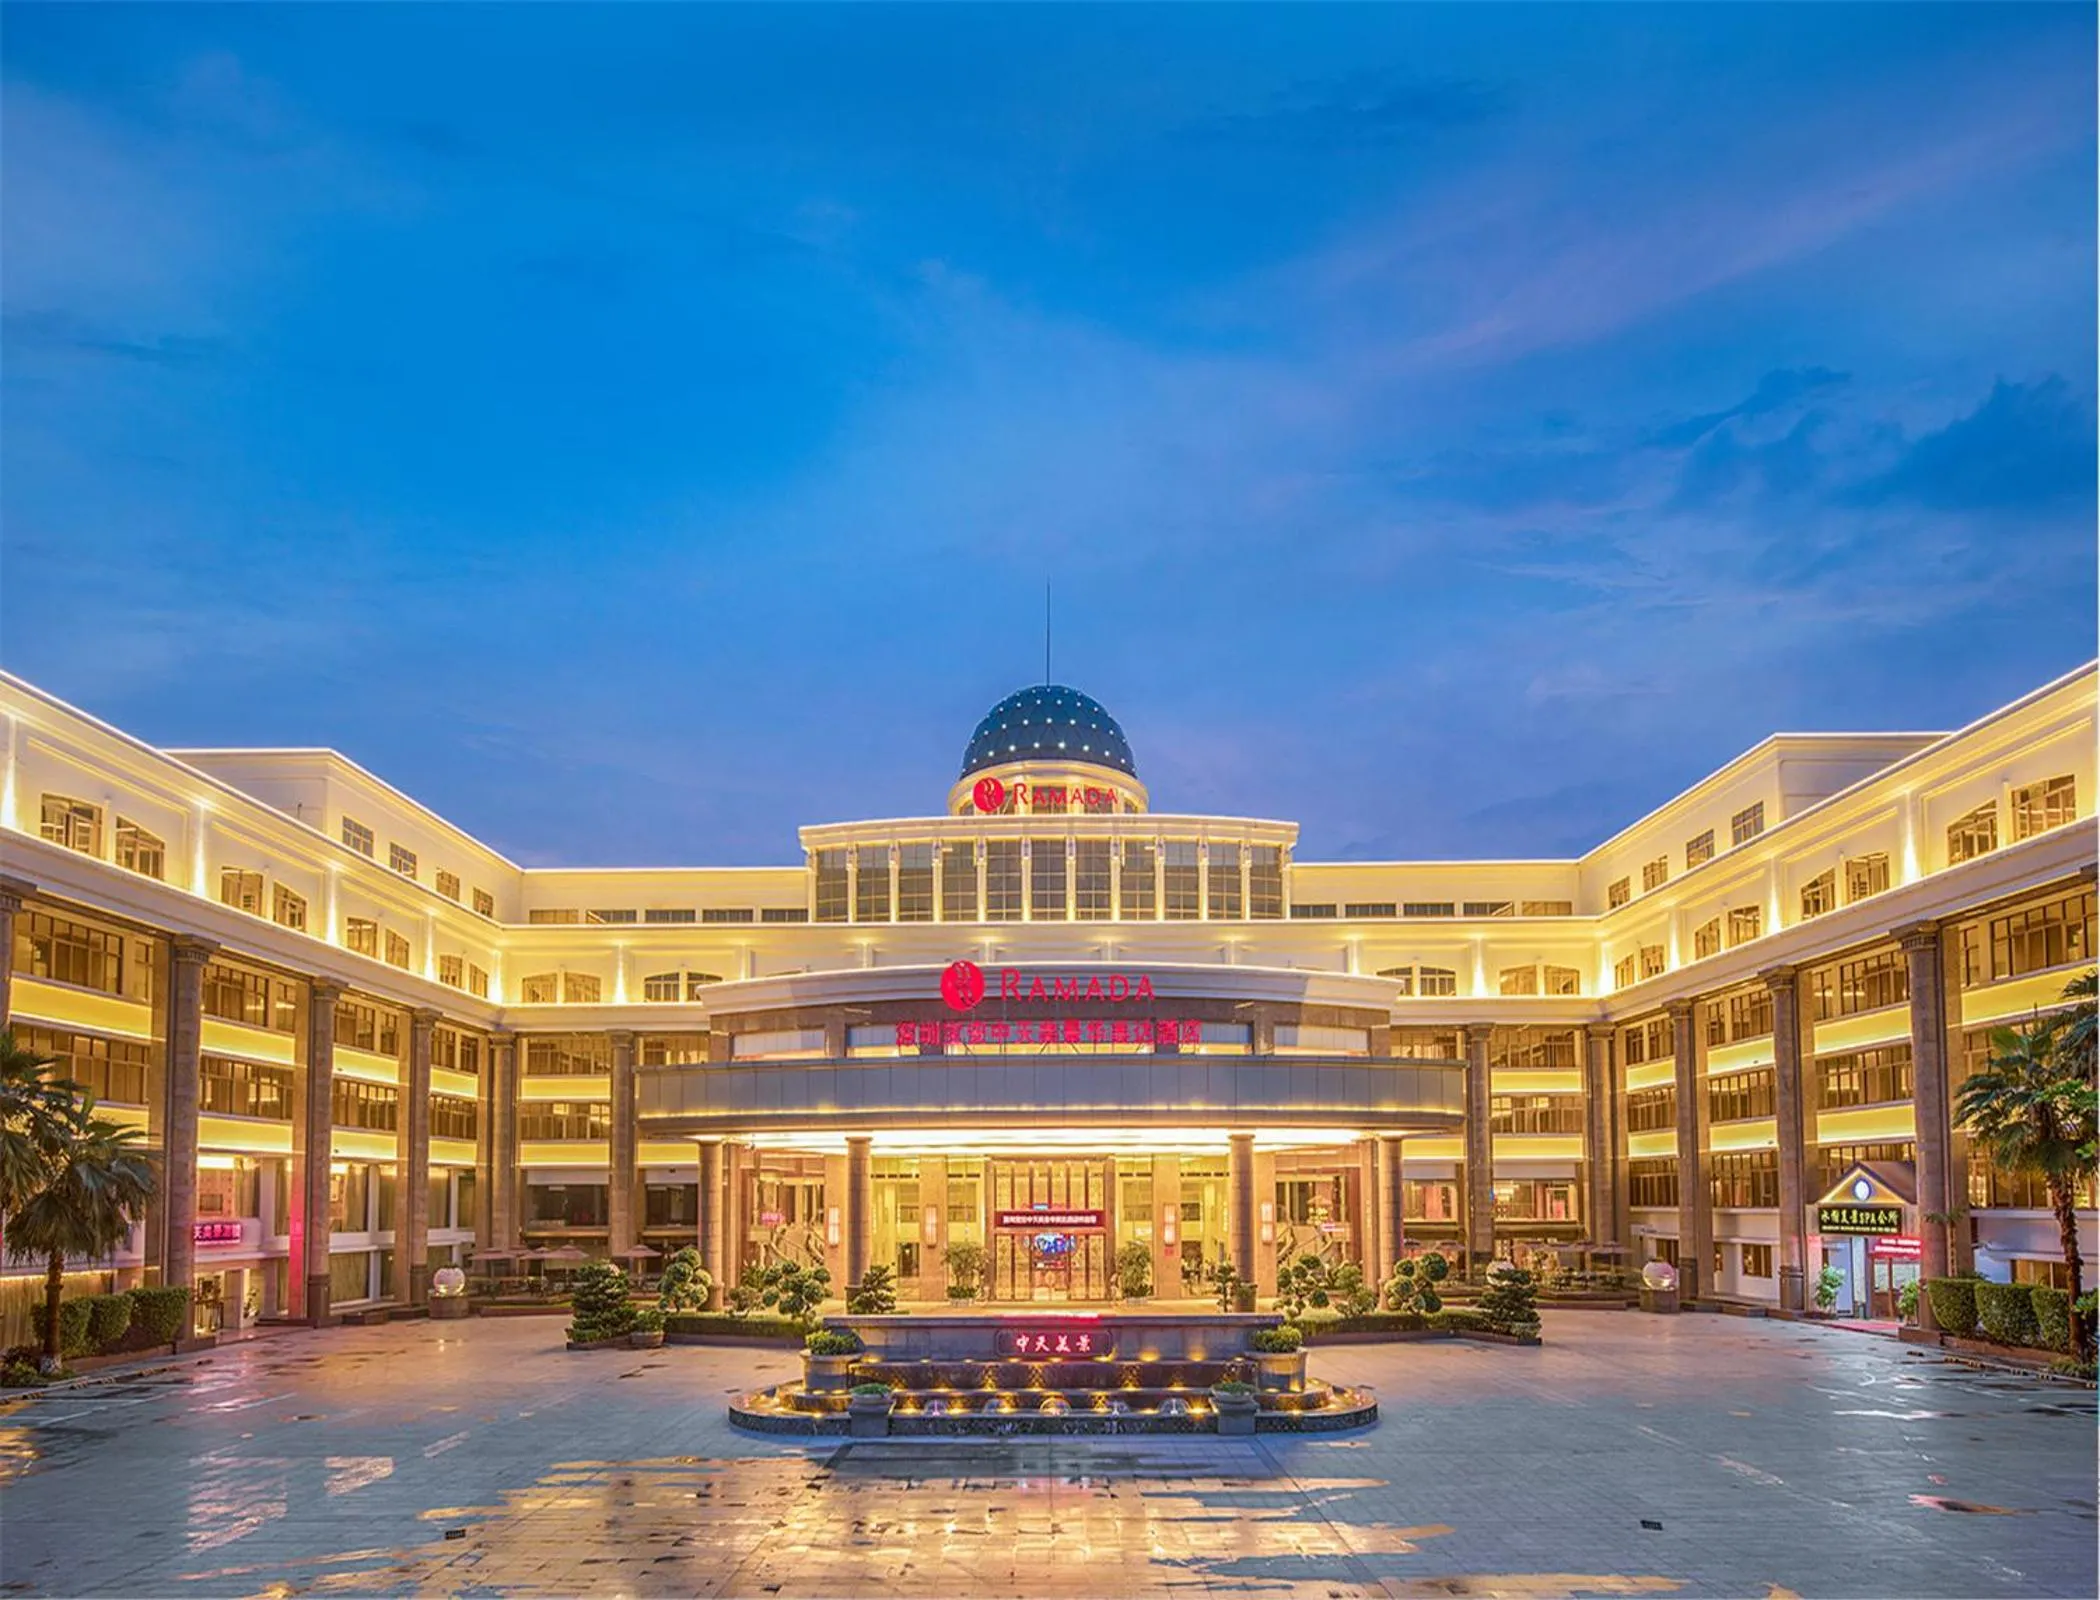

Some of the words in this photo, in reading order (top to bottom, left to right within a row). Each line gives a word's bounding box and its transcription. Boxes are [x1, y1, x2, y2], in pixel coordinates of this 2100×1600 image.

[1013, 783, 1119, 805] RAMADA
[1000, 967, 1156, 1001] RAMADA
[1015, 1334, 1092, 1353] 中天美景
